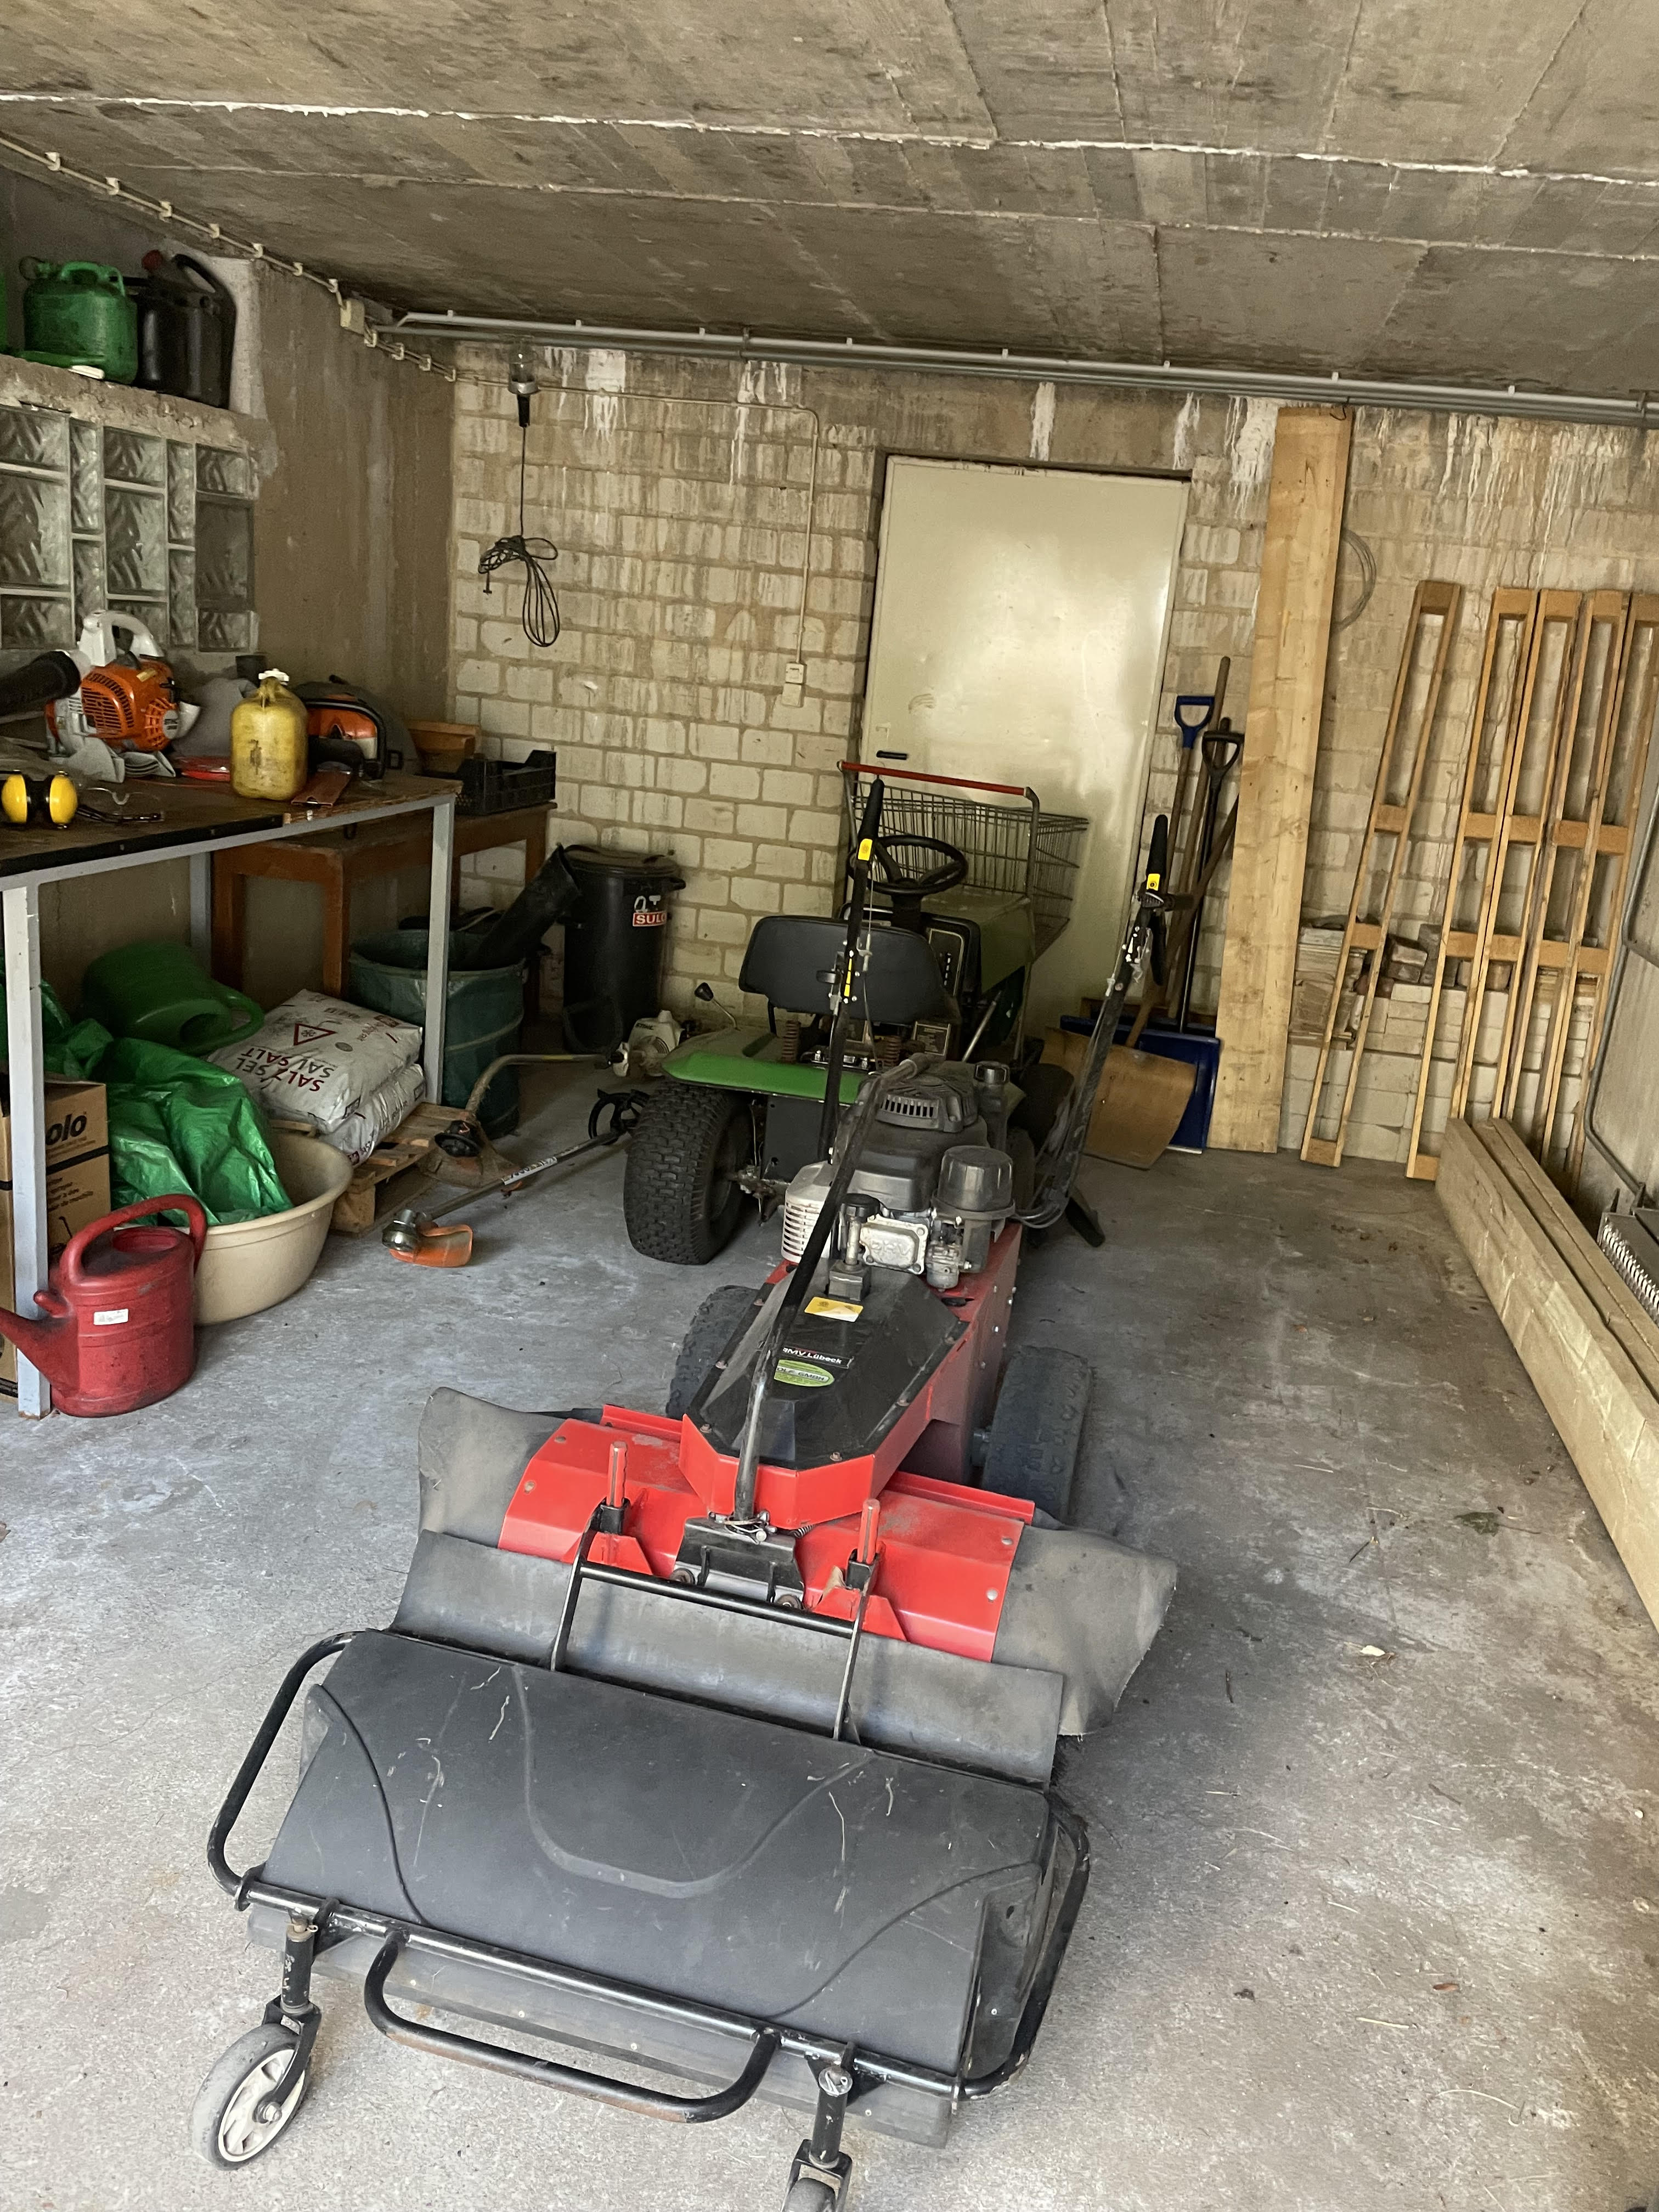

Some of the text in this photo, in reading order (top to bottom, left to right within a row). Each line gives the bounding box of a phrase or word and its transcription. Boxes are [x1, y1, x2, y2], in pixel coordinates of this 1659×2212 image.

[636, 914, 666, 924] SULO
[236, 1058, 270, 1075] SEL
[241, 1048, 335, 1078] SAL SALT
[45, 1114, 87, 1146] olo
[806, 1353, 842, 1364] Lübeck
